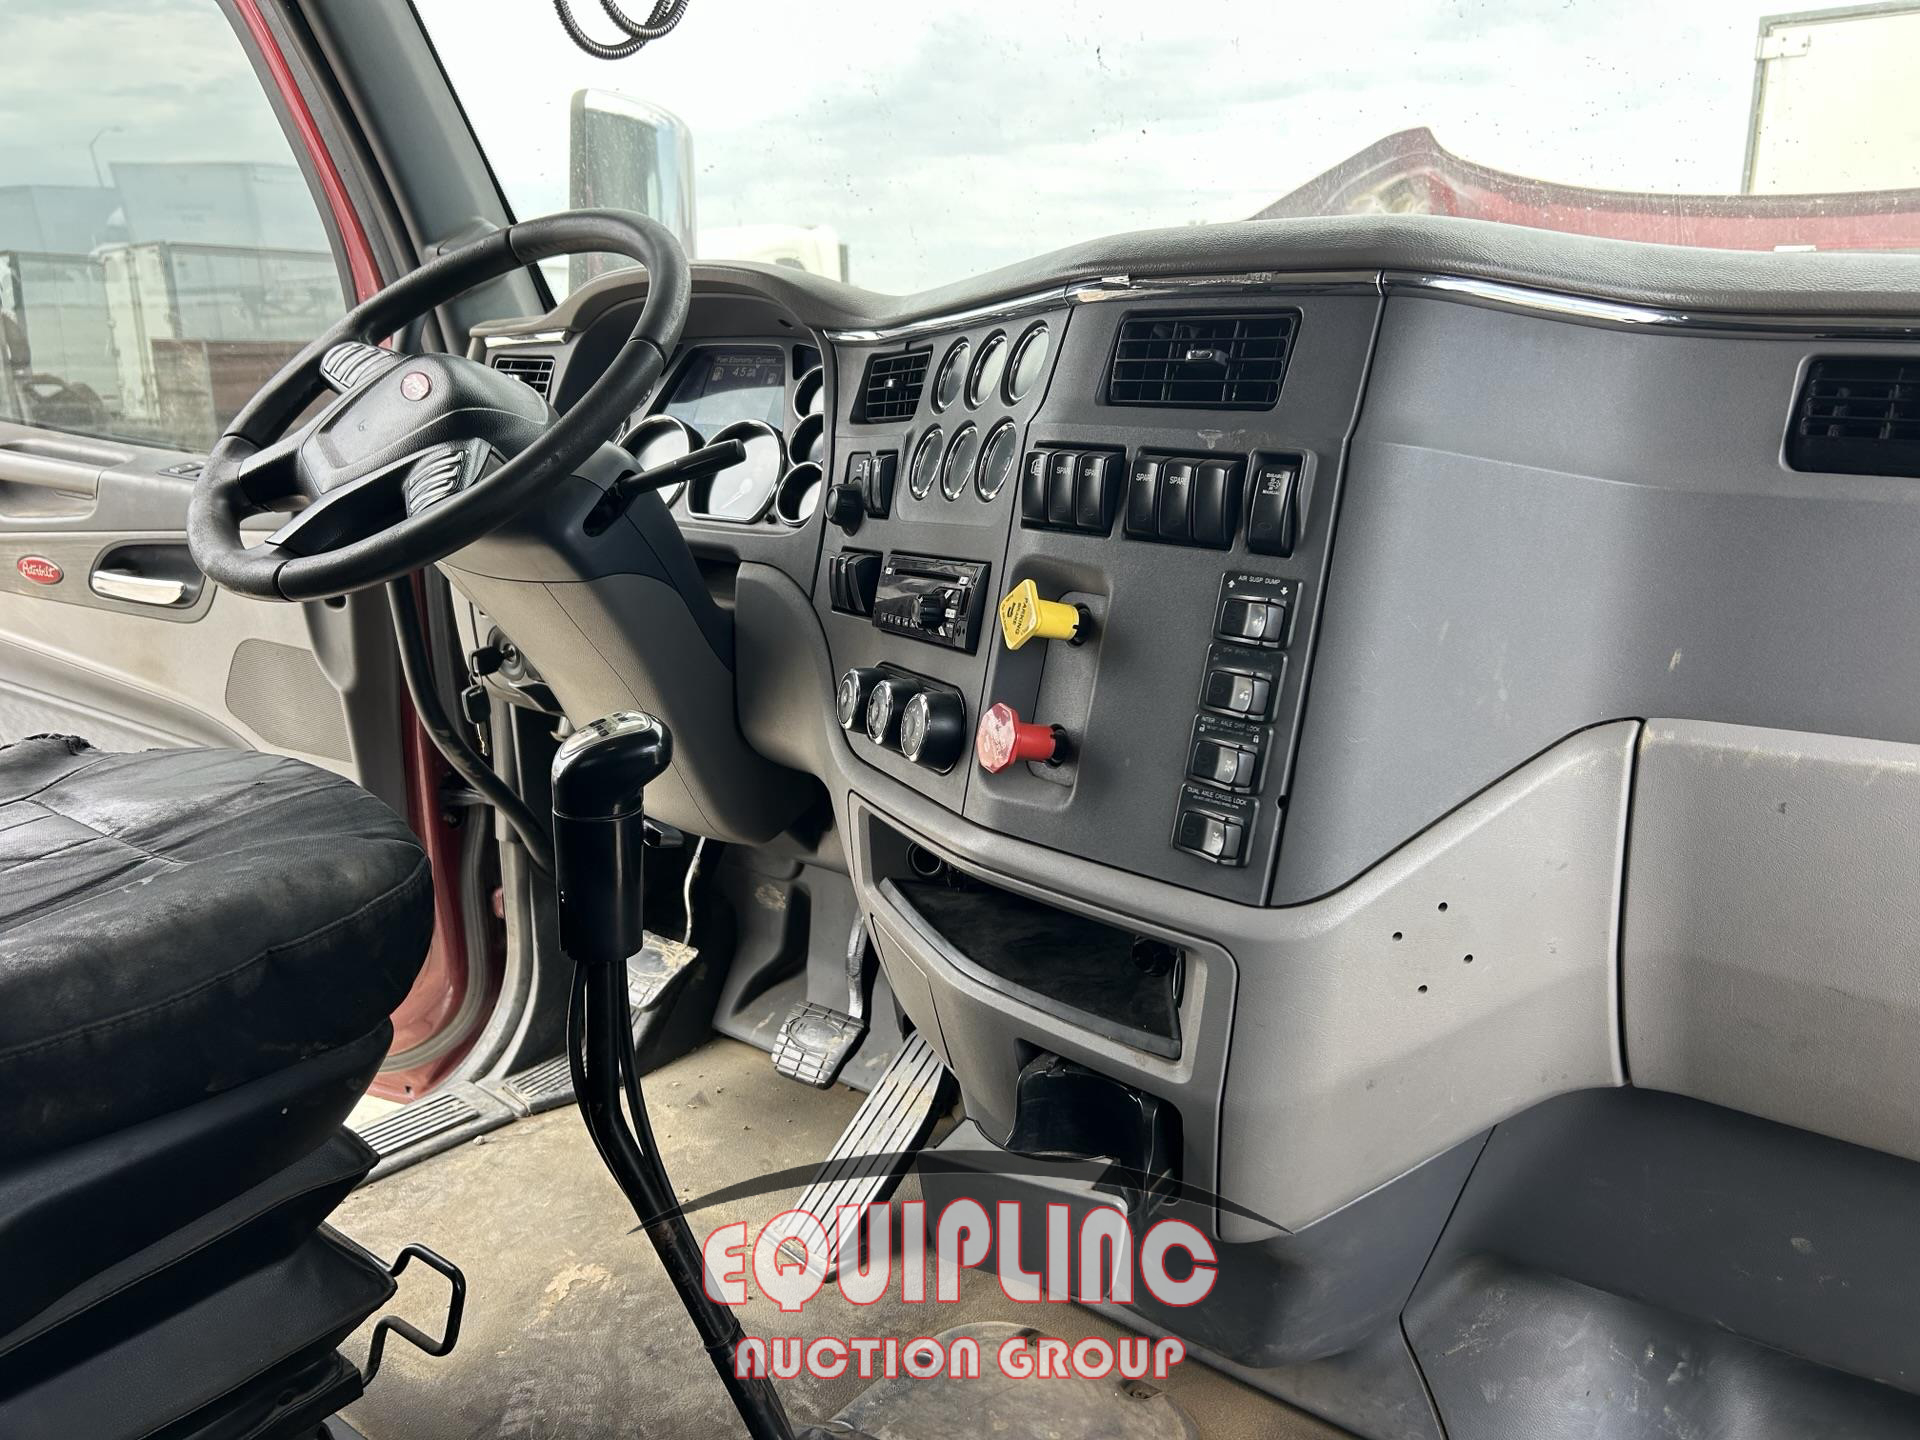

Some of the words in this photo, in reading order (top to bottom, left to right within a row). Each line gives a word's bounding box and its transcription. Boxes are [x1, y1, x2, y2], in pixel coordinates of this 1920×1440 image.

[22, 560, 54, 578] Peterbilt
[1265, 577, 1281, 585] DUMP
[1187, 786, 1200, 794] DUAL
[1201, 790, 1214, 798] AXLE
[1233, 797, 1248, 806] LOCK
